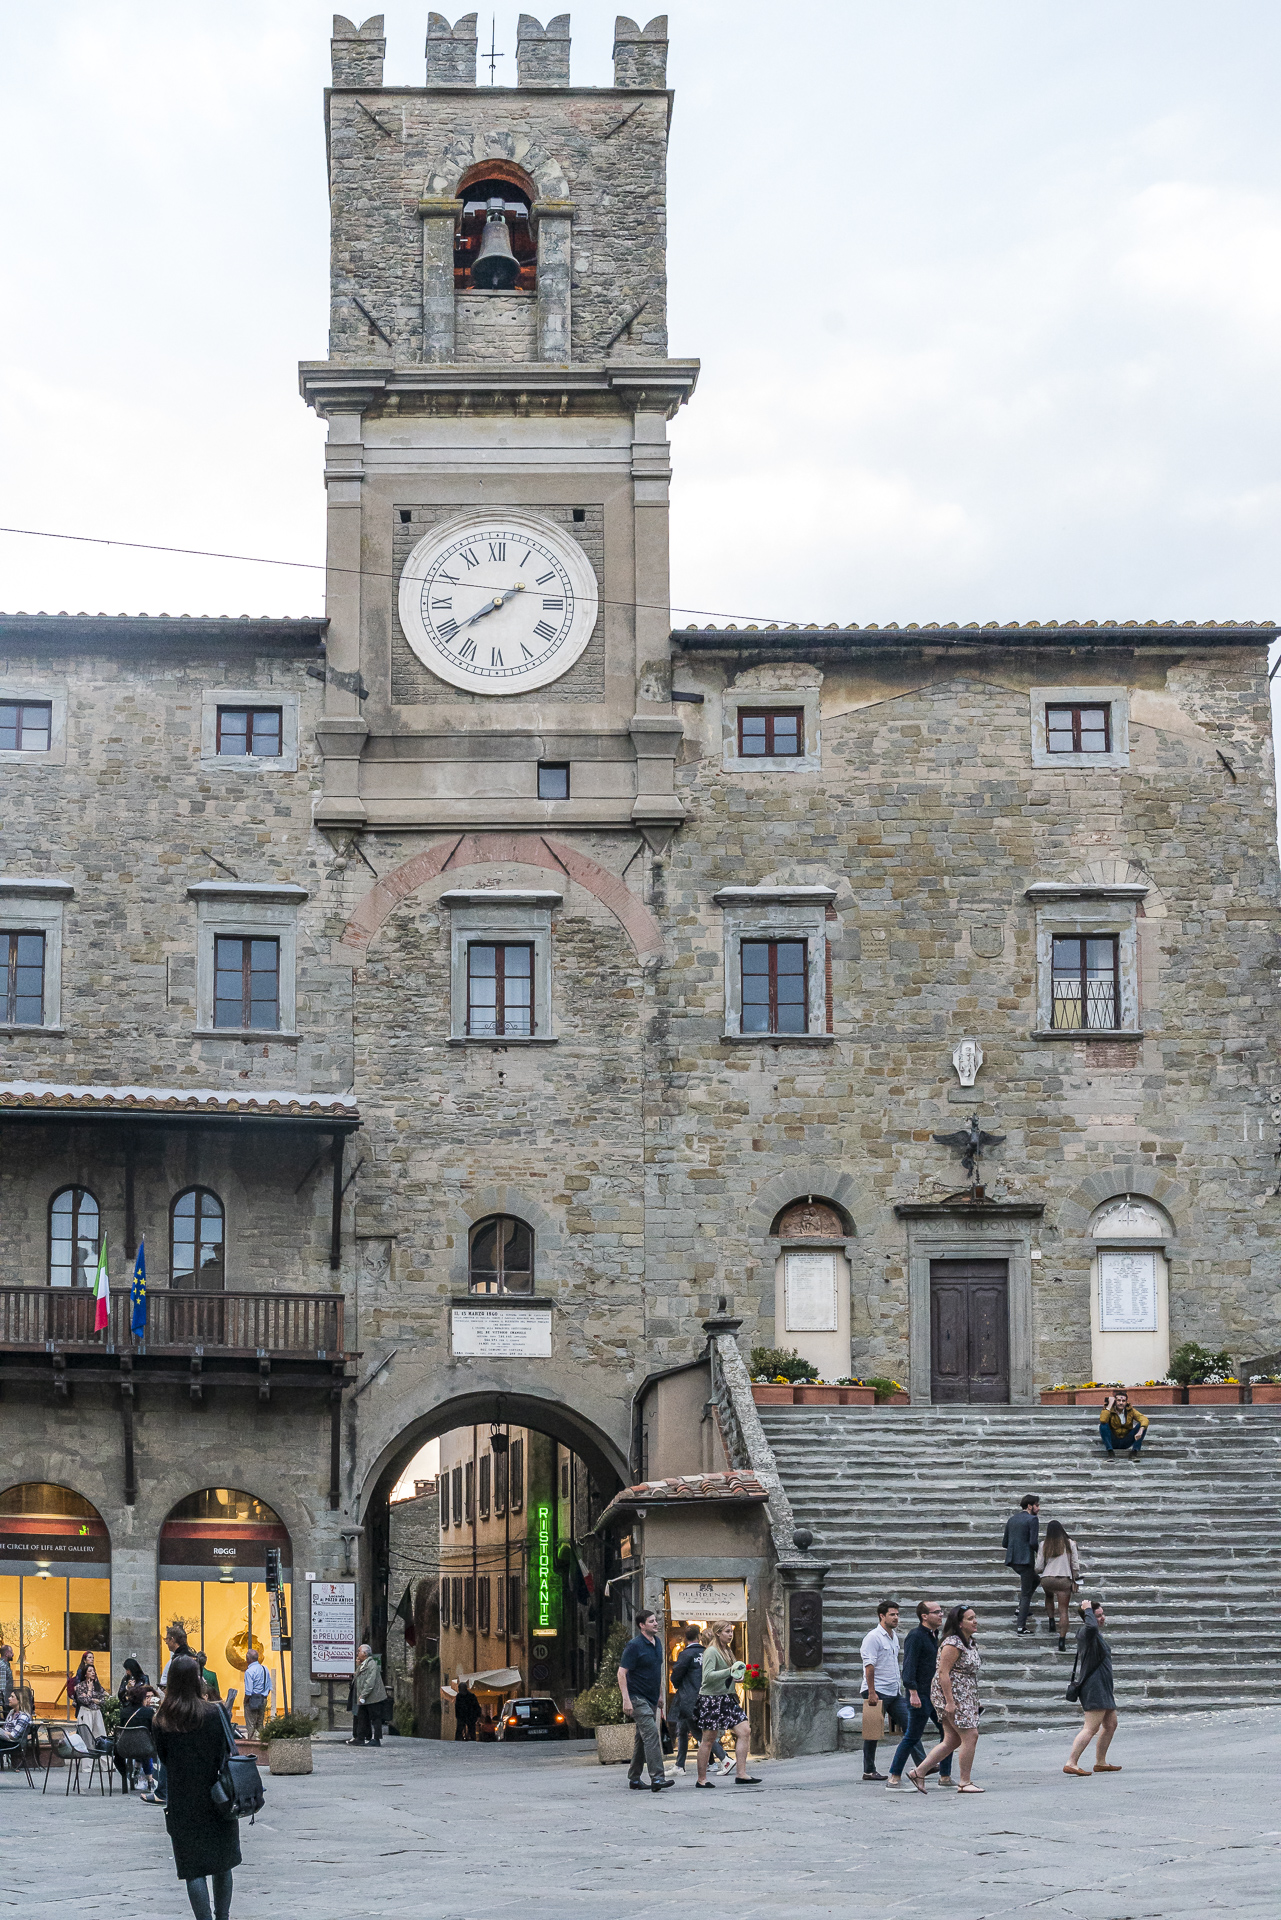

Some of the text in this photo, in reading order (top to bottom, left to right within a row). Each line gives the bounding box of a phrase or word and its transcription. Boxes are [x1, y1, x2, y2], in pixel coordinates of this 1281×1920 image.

[459, 547, 480, 570] XI
[488, 542, 506, 561] XII
[519, 550, 531, 567] I
[439, 569, 460, 586] X
[535, 571, 556, 585] II
[431, 596, 452, 609] IX
[543, 599, 563, 610] III
[458, 637, 477, 662] VII
[491, 646, 504, 666] VI
[519, 642, 533, 660] V
[213, 1547, 236, 1555] ROGGI
[538, 1507, 549, 1625] RISTORANTE
[535, 1646, 546, 1657] 10
